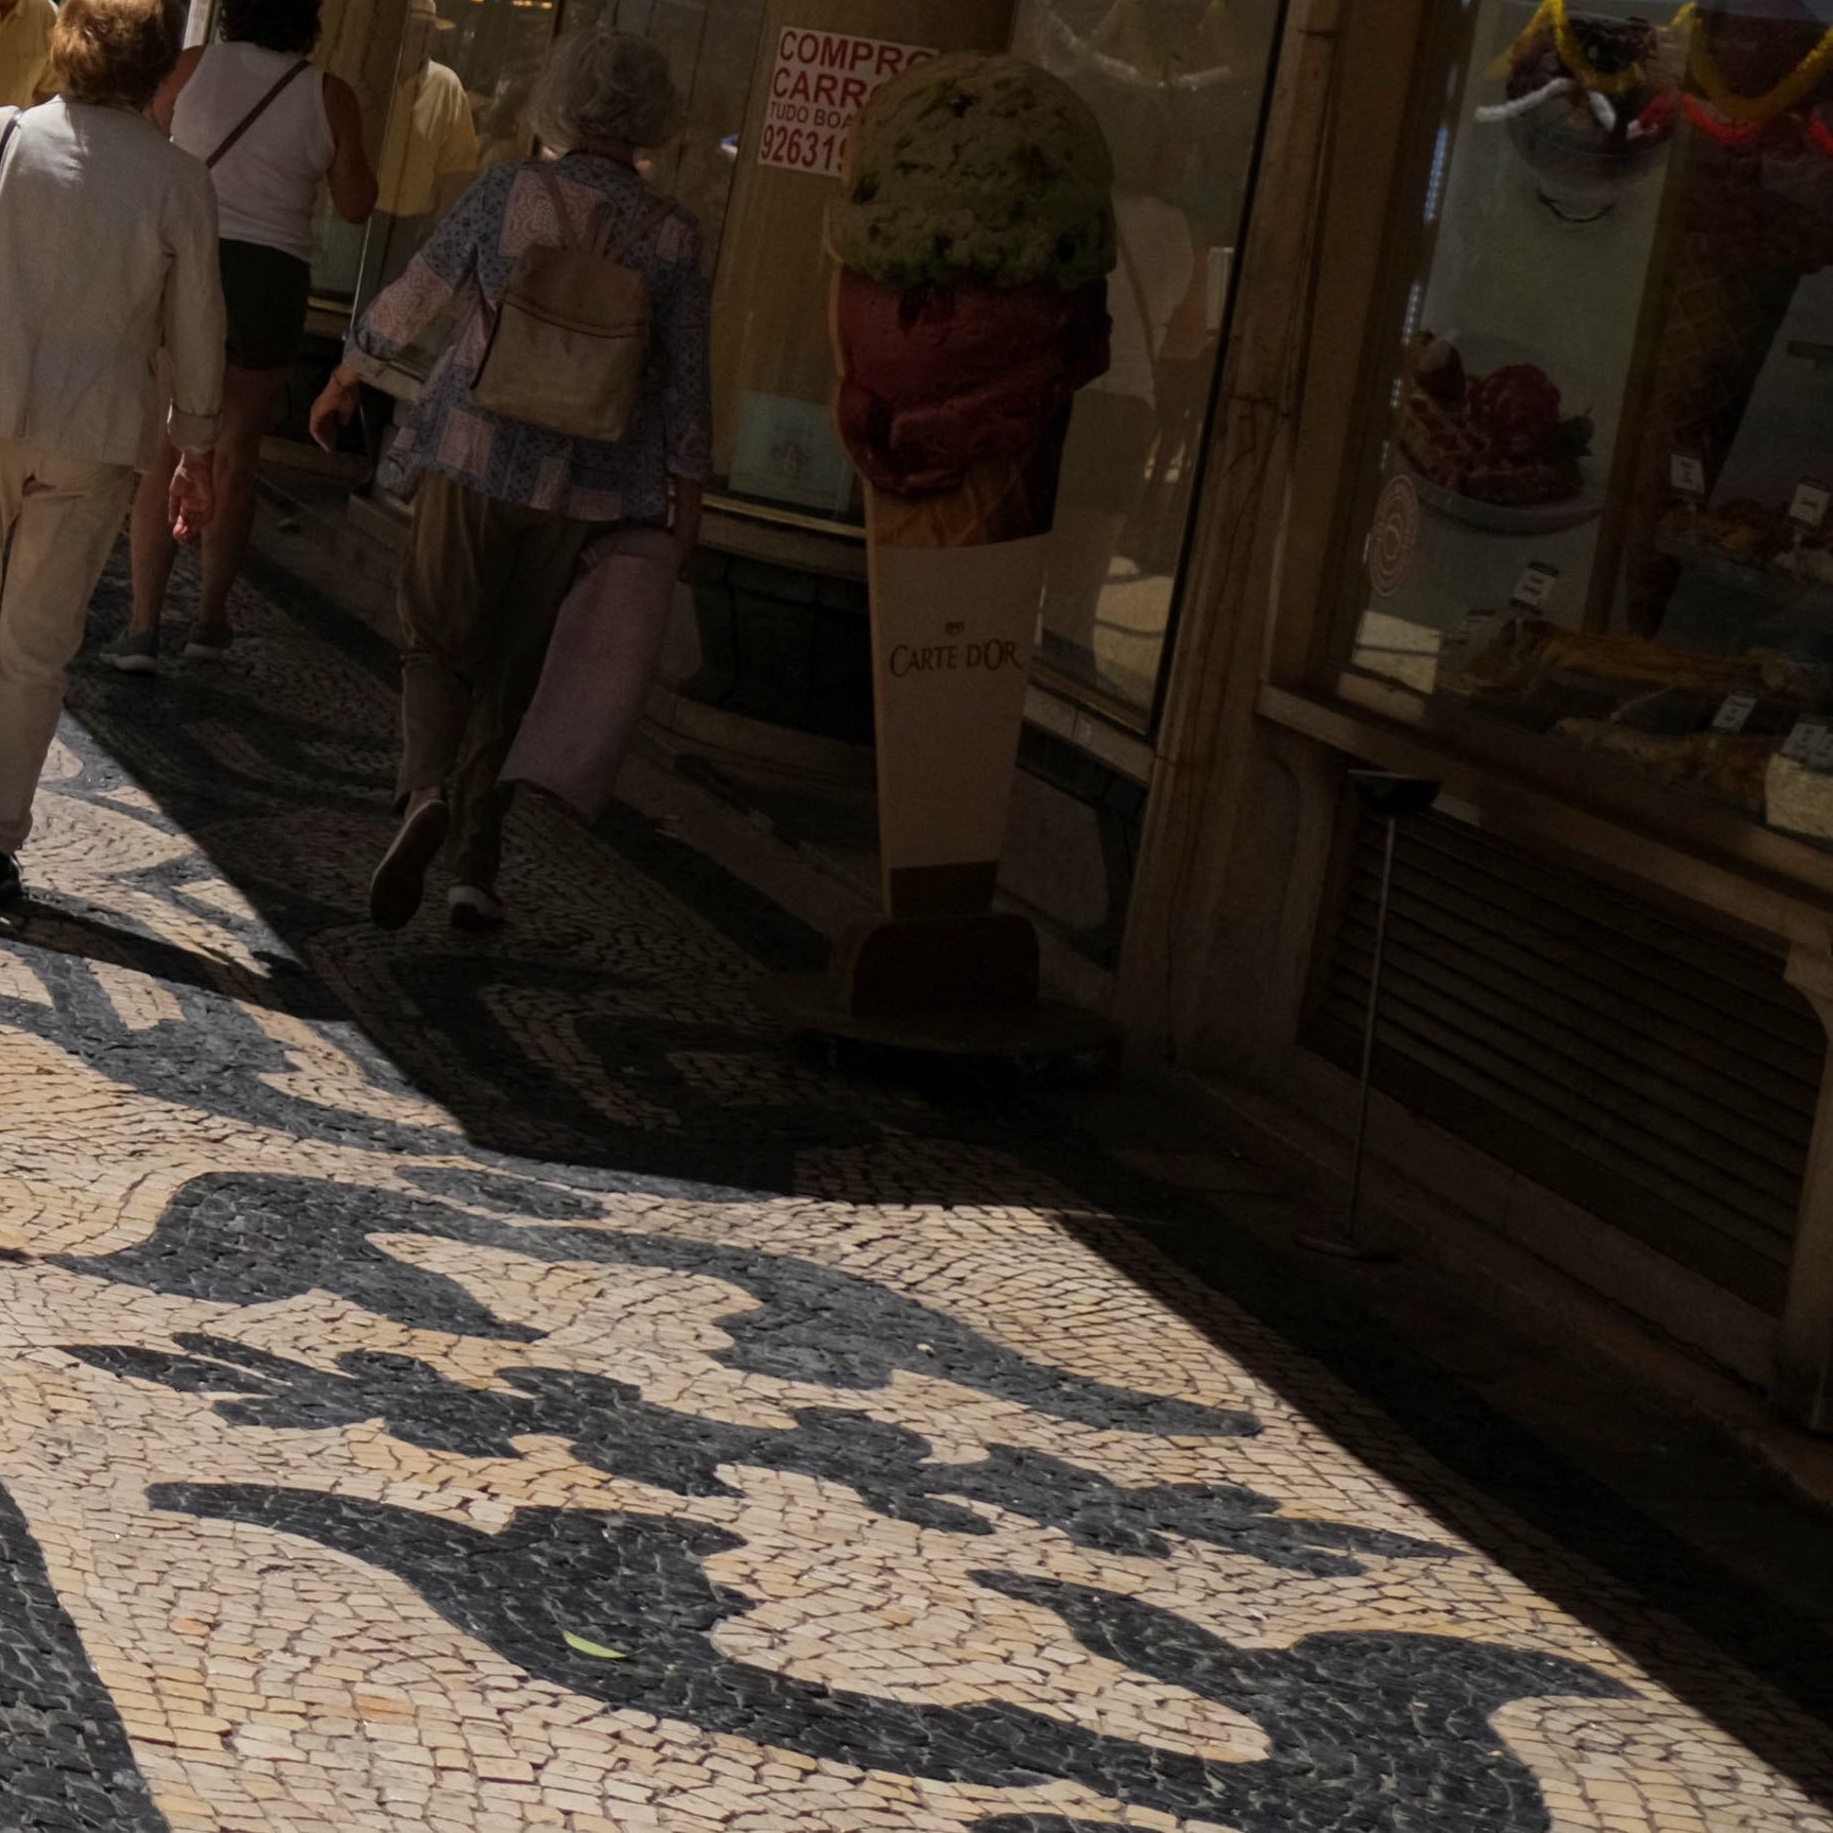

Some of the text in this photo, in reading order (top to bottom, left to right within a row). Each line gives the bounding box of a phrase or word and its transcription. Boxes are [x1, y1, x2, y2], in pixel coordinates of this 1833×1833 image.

[773, 68, 881, 109] CARR
[770, 101, 810, 123] TUDO
[890, 645, 959, 678] CARTE
